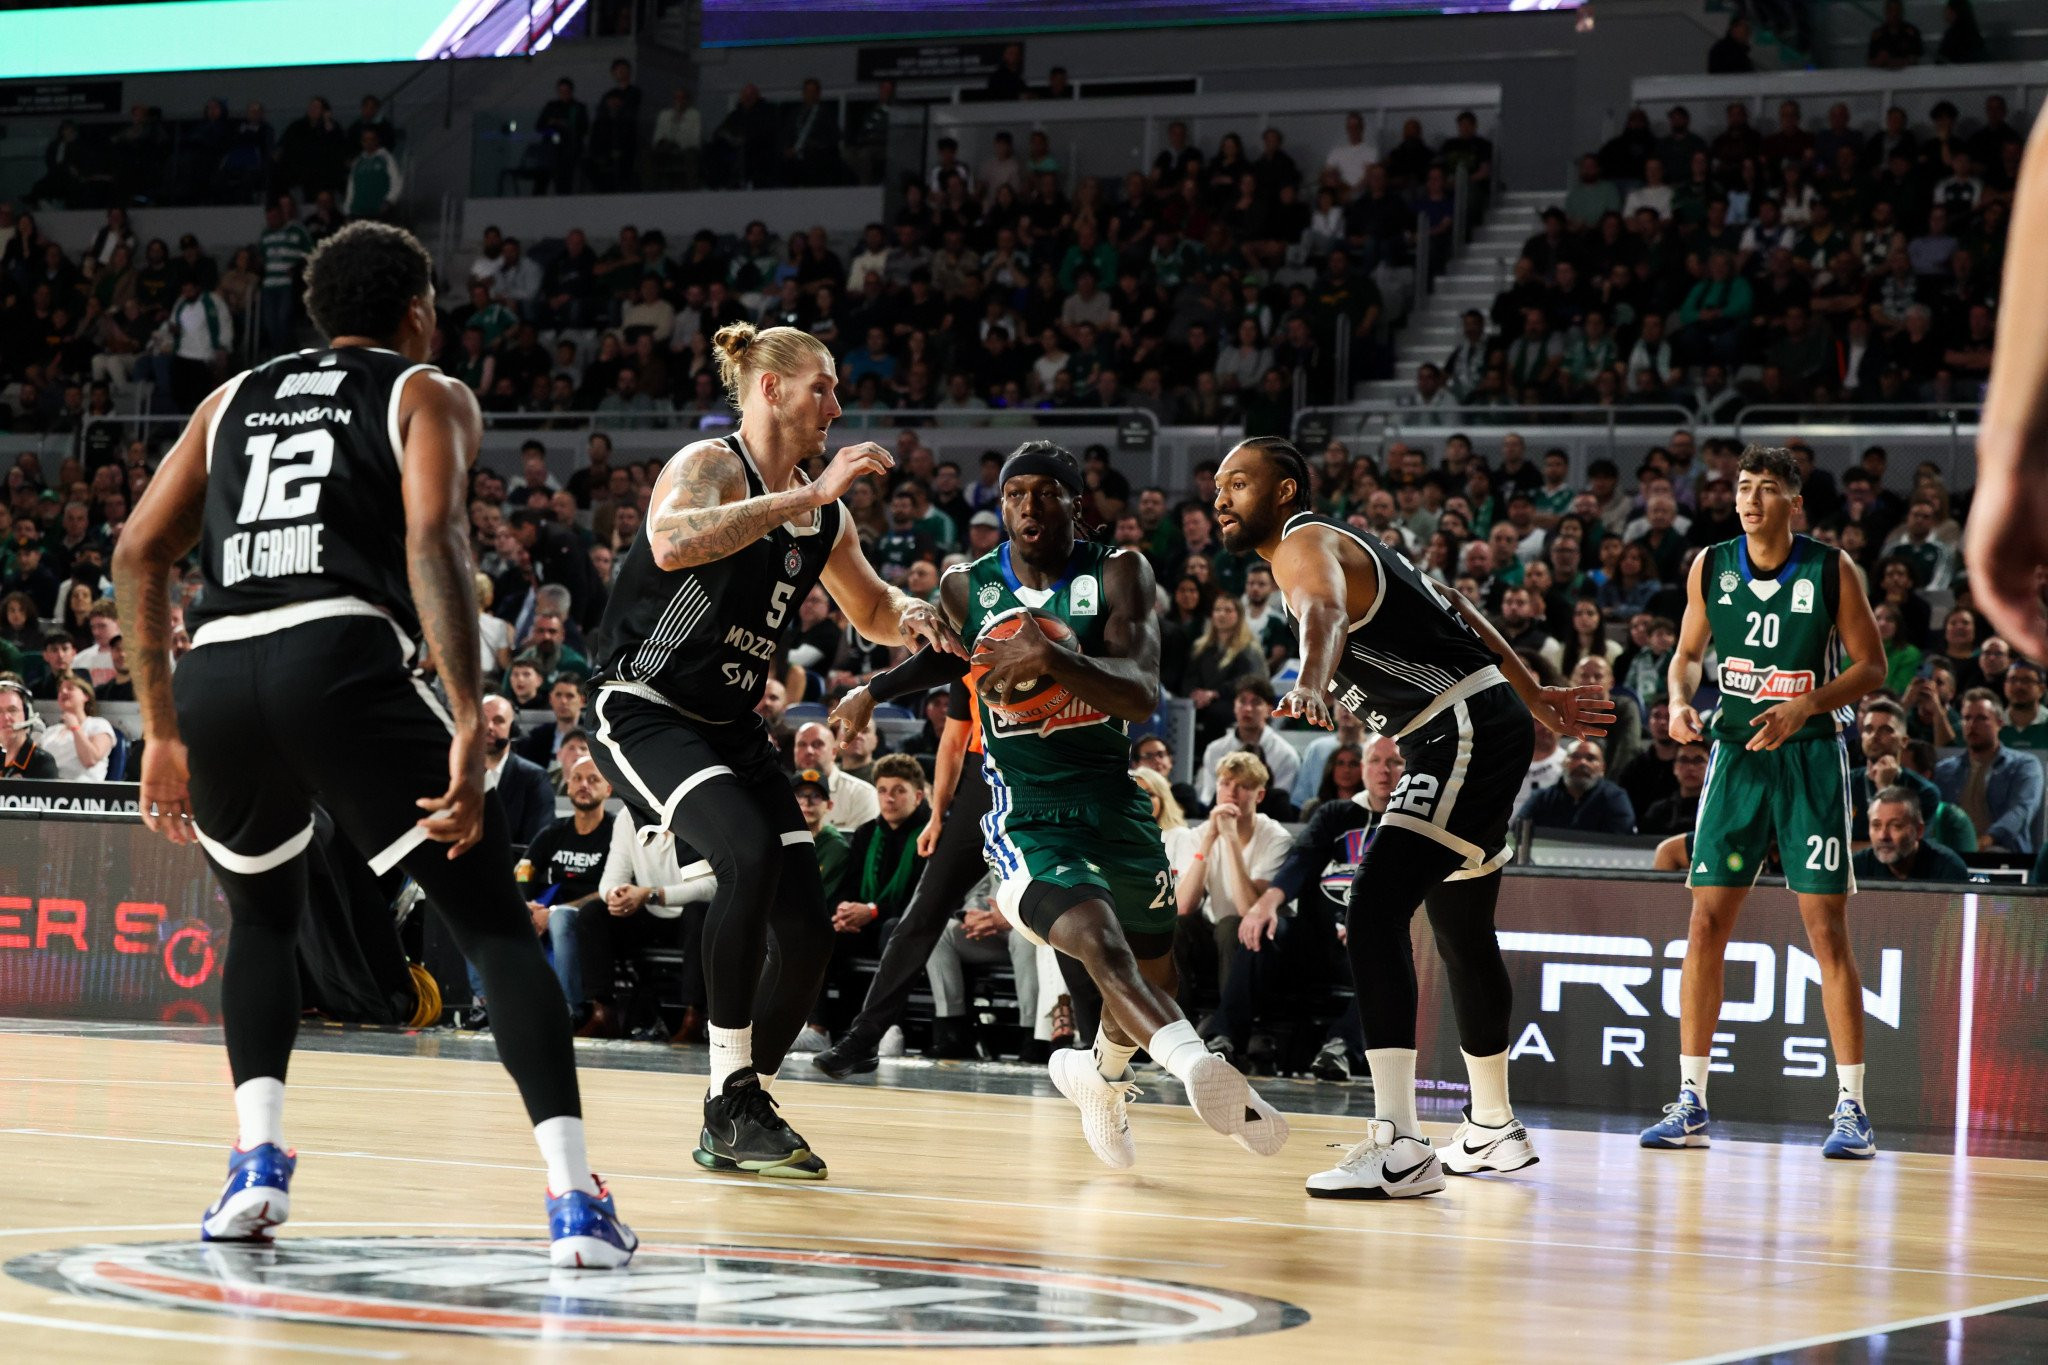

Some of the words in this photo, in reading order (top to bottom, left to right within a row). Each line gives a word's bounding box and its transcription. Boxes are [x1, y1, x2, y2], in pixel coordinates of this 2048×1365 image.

[244, 406, 352, 427] CHANGAN
[236, 428, 335, 525] 12
[222, 523, 324, 588] BELGRADE
[766, 580, 796, 629] 5
[1745, 611, 1780, 648] 20
[53, 797, 105, 812] CAIN
[1386, 773, 1439, 817] 22
[551, 850, 602, 867] ATHENS
[1806, 835, 1840, 872] 20
[1508, 1023, 1827, 1077] ARES
[1437, 1080, 1469, 1093] Disney
